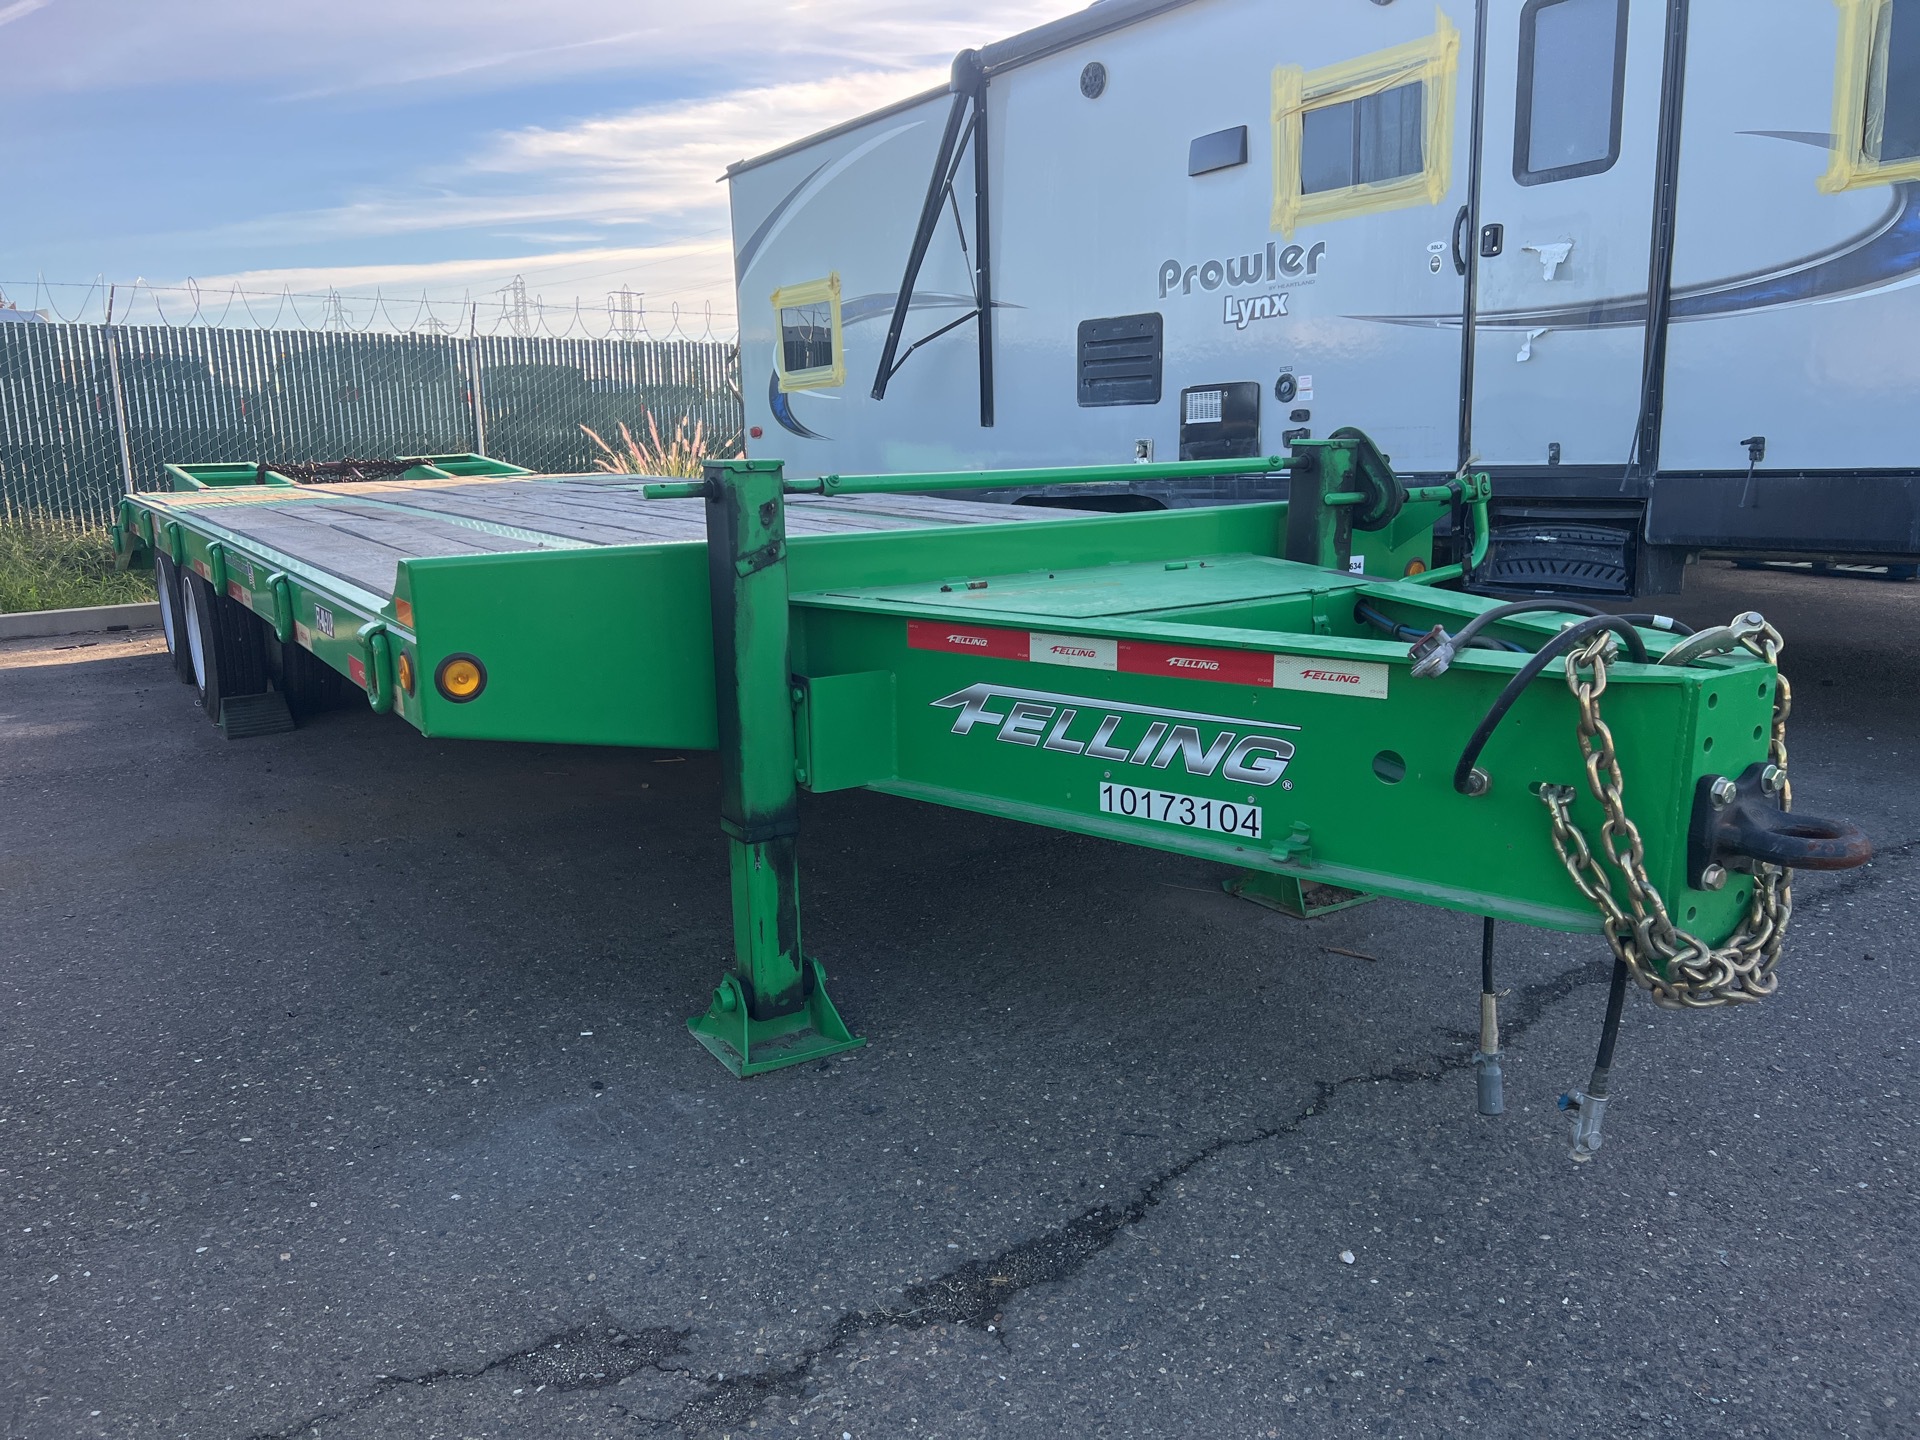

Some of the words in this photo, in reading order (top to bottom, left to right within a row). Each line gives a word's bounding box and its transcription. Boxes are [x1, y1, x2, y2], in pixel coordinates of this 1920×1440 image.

[1158, 241, 1326, 299] Prowler
[1278, 279, 1316, 290] HEARTLAND
[1223, 292, 1289, 330] Lynx
[1103, 785, 1260, 837] 10173104
